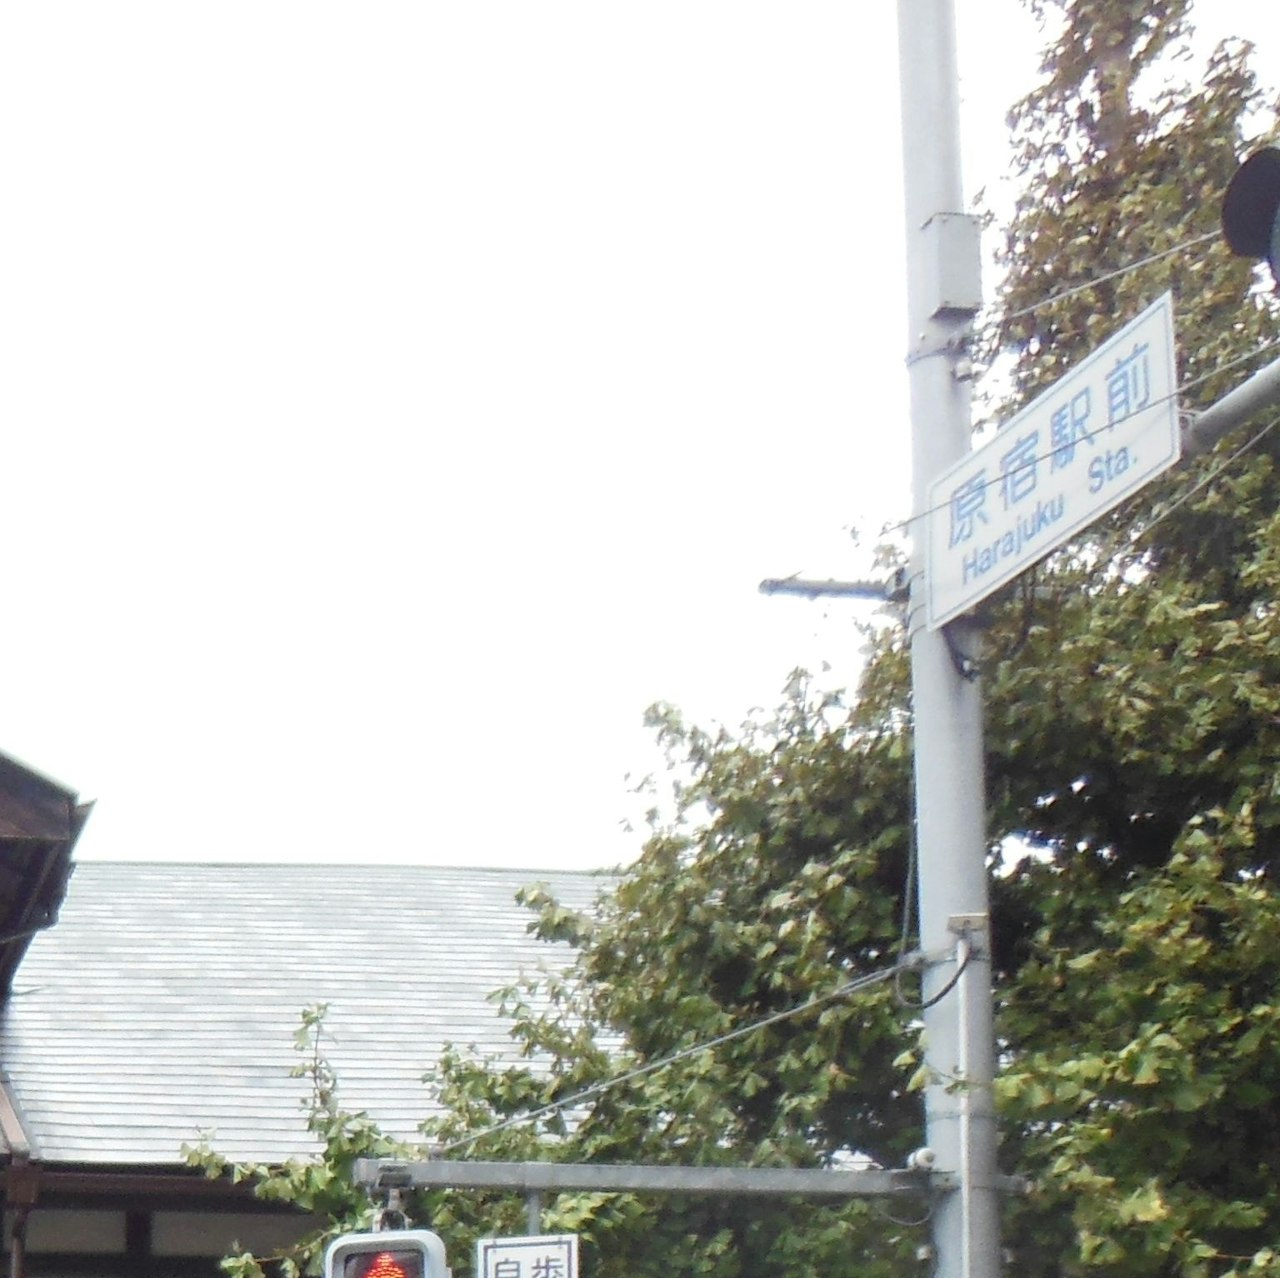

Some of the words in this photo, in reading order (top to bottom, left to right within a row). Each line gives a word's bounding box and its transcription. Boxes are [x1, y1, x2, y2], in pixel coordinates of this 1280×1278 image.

[948, 342, 1149, 550] 原宿駅前
[962, 494, 1065, 585] Harajuku
[1087, 446, 1138, 494] Sta.
